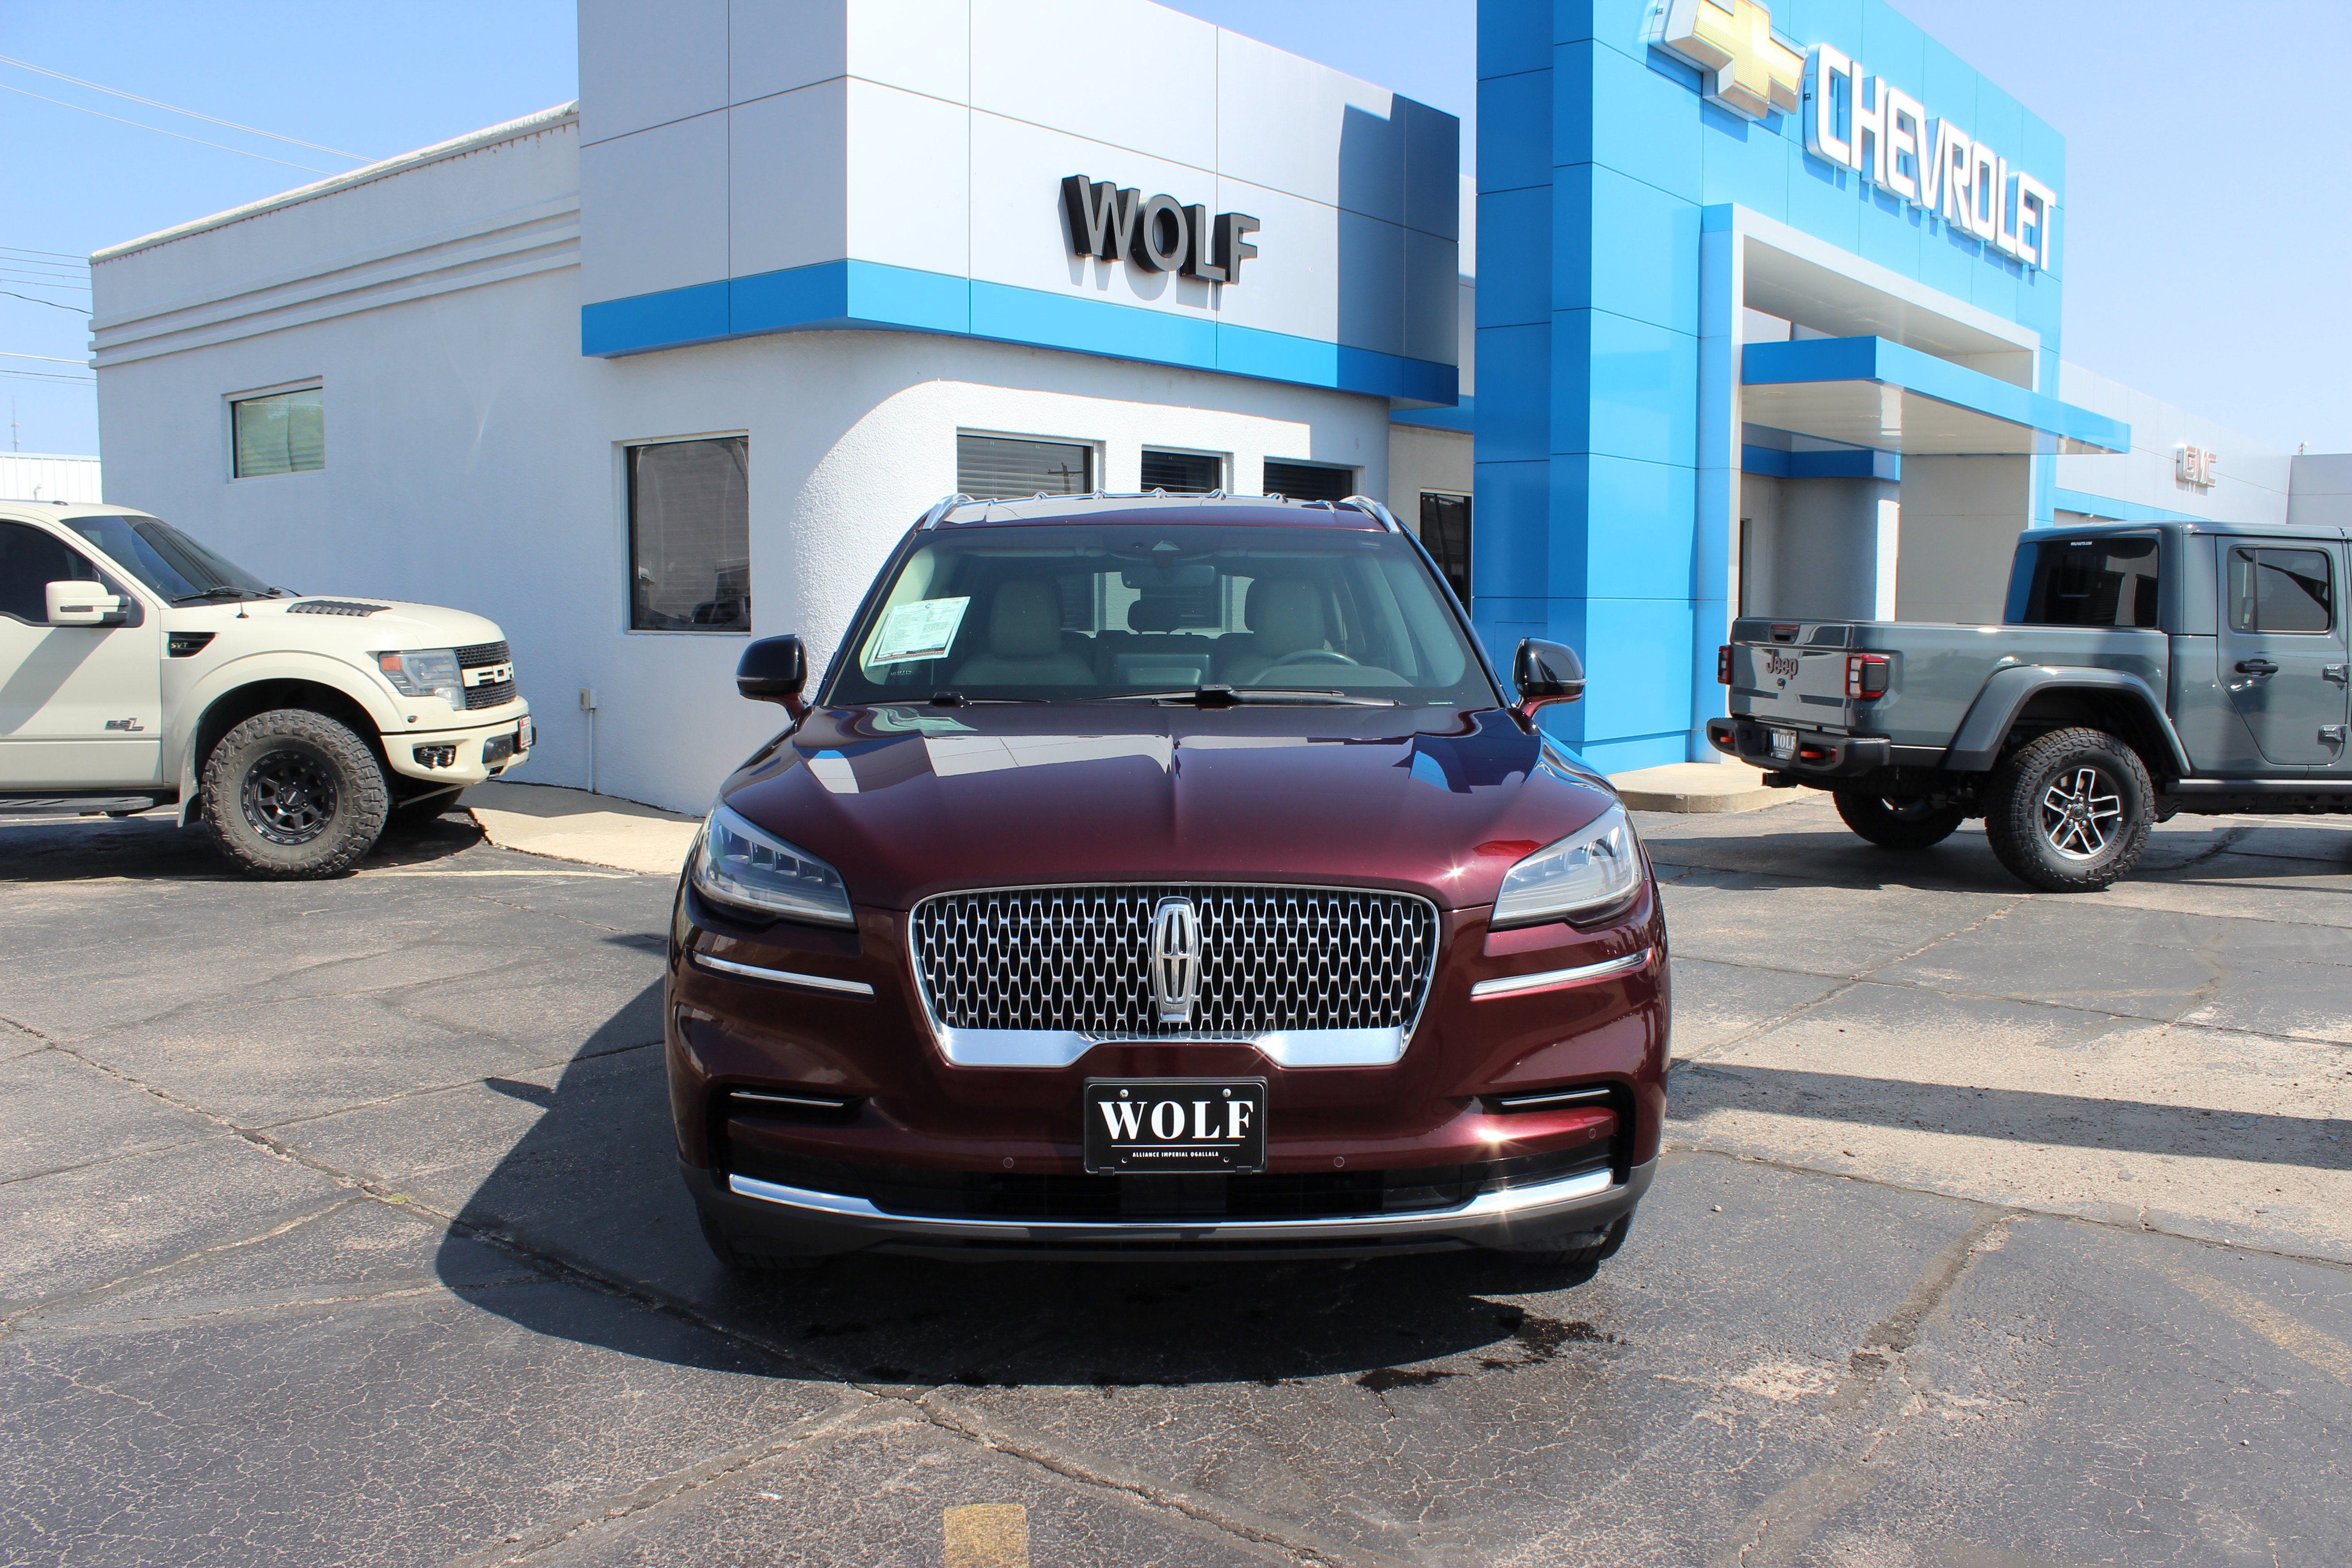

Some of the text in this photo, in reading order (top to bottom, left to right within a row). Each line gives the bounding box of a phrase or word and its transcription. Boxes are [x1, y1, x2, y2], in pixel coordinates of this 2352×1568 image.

[1806, 42, 2056, 272] CHEVROLET
[1062, 174, 1260, 285] WOLF
[2180, 443, 2217, 488] GMC
[1766, 650, 1798, 680] Jeep
[104, 717, 145, 732] 6.2L
[1772, 732, 1796, 750] WOLF
[1098, 1100, 1254, 1140] WOLF
